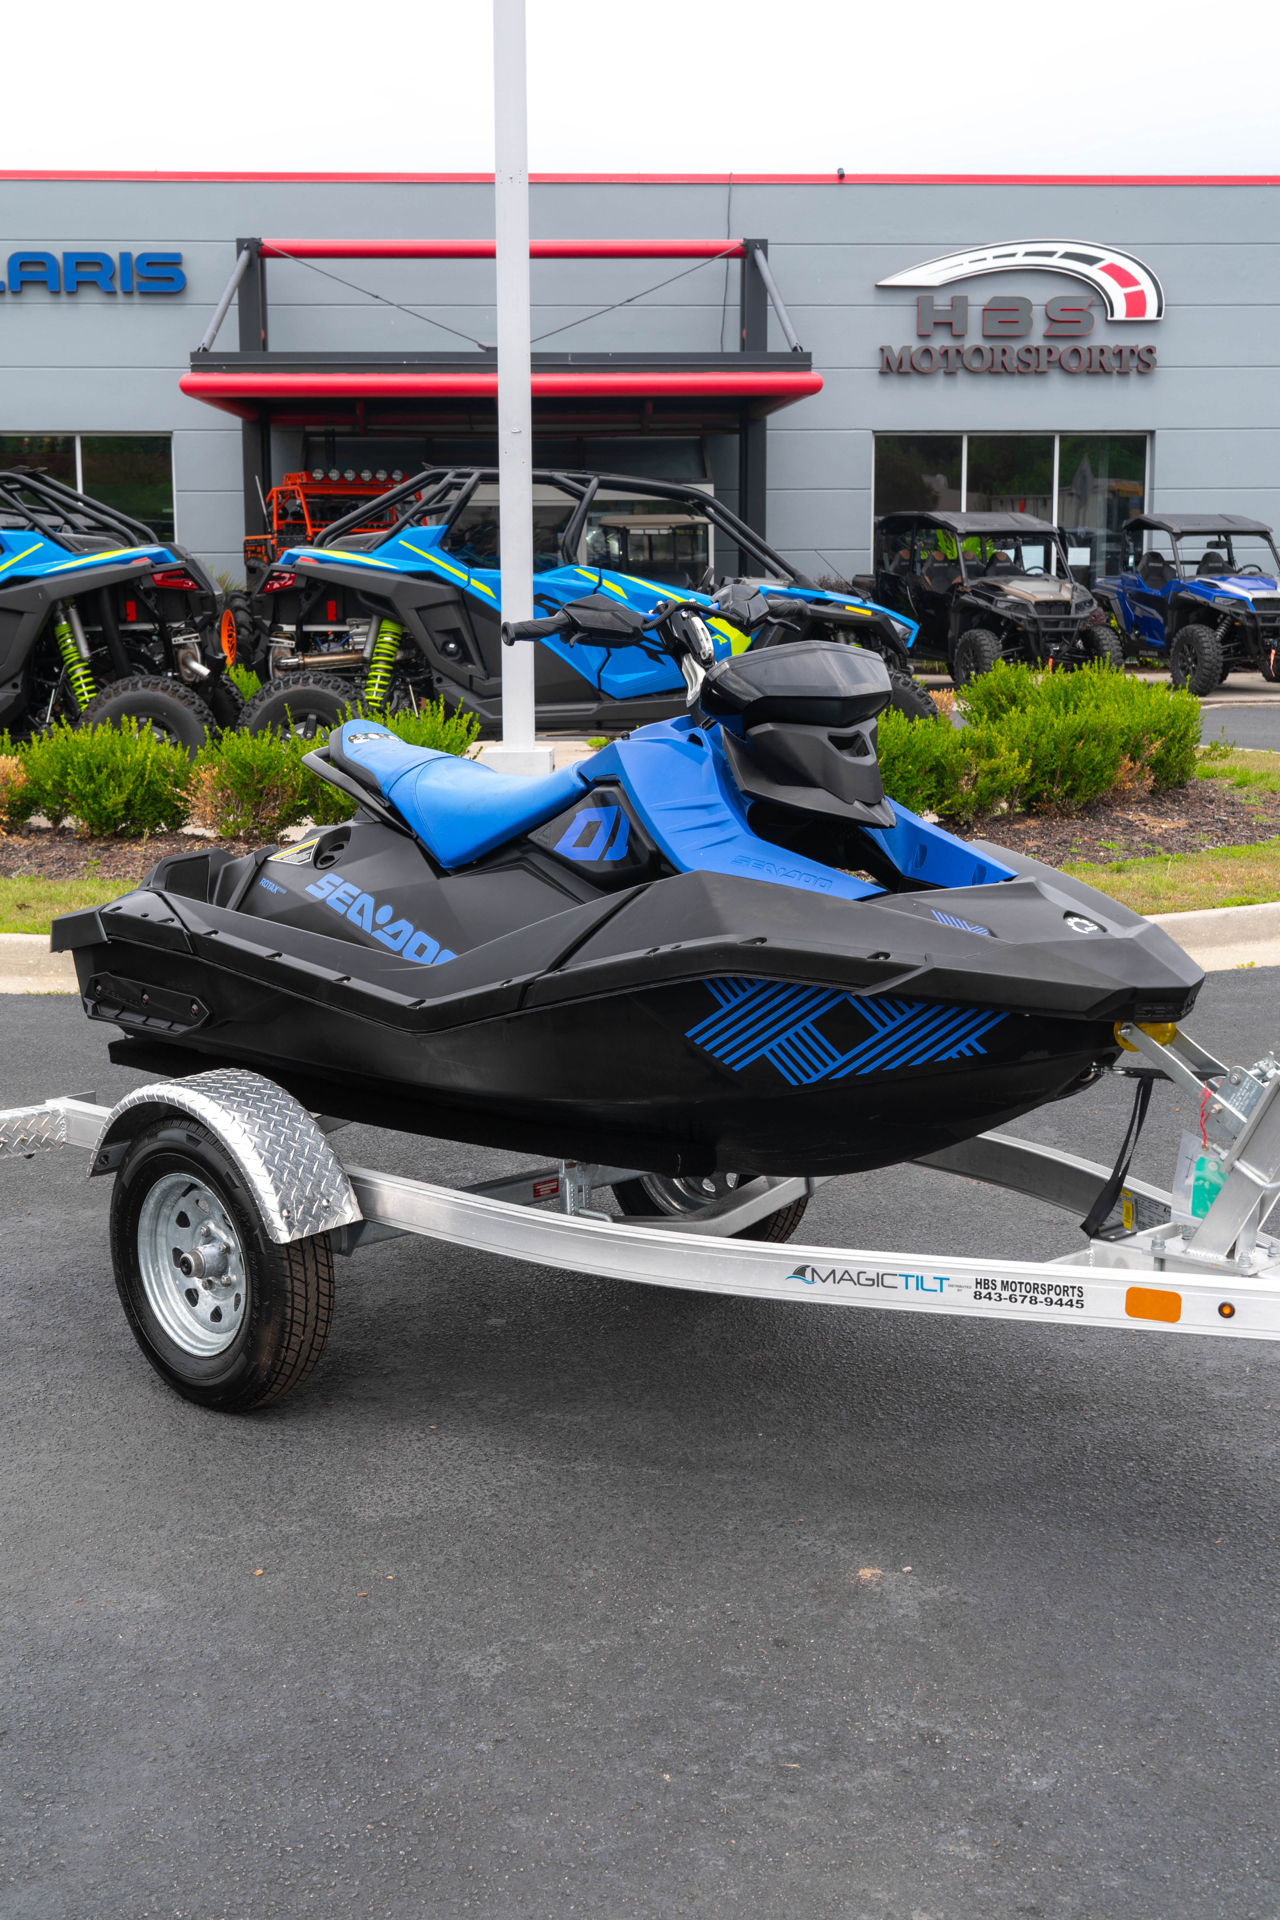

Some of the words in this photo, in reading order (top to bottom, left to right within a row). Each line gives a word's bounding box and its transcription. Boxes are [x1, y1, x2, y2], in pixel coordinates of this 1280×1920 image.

[0, 252, 186, 293] ARIS
[917, 295, 1095, 336] HBS
[879, 344, 1158, 374] MOTORSPORTS
[259, 877, 279, 894] ROTAX
[973, 1290, 1085, 1309] 843-678-9445
[975, 1277, 997, 1291] HBS
[1000, 1280, 1084, 1298] MOTORSPORTS
